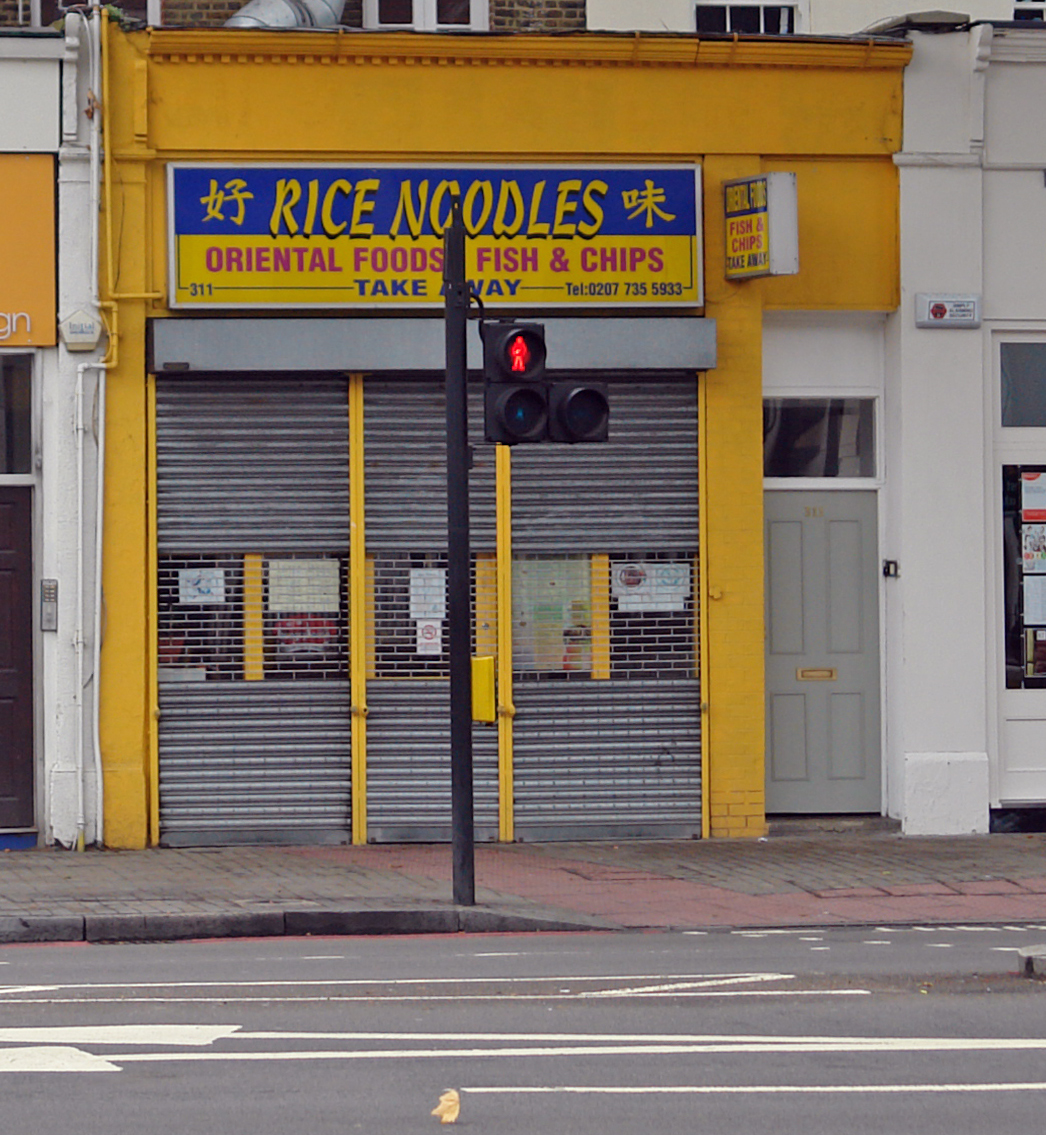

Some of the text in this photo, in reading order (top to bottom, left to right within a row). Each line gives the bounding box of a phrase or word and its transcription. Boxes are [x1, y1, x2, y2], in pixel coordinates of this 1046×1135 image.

[200, 179, 254, 226] 好
[270, 178, 609, 240] RICE NOODLES
[621, 179, 677, 228] 味
[730, 217, 764, 236] FISH &
[732, 234, 763, 253] CHIPS
[205, 247, 665, 273] ORIENTAL FOODS FISH & CHIPS
[727, 254, 746, 270] TAKE
[190, 284, 213, 296] 311
[353, 279, 522, 297] TAKE WAY
[566, 282, 683, 297] Tel:0207 735 5933
